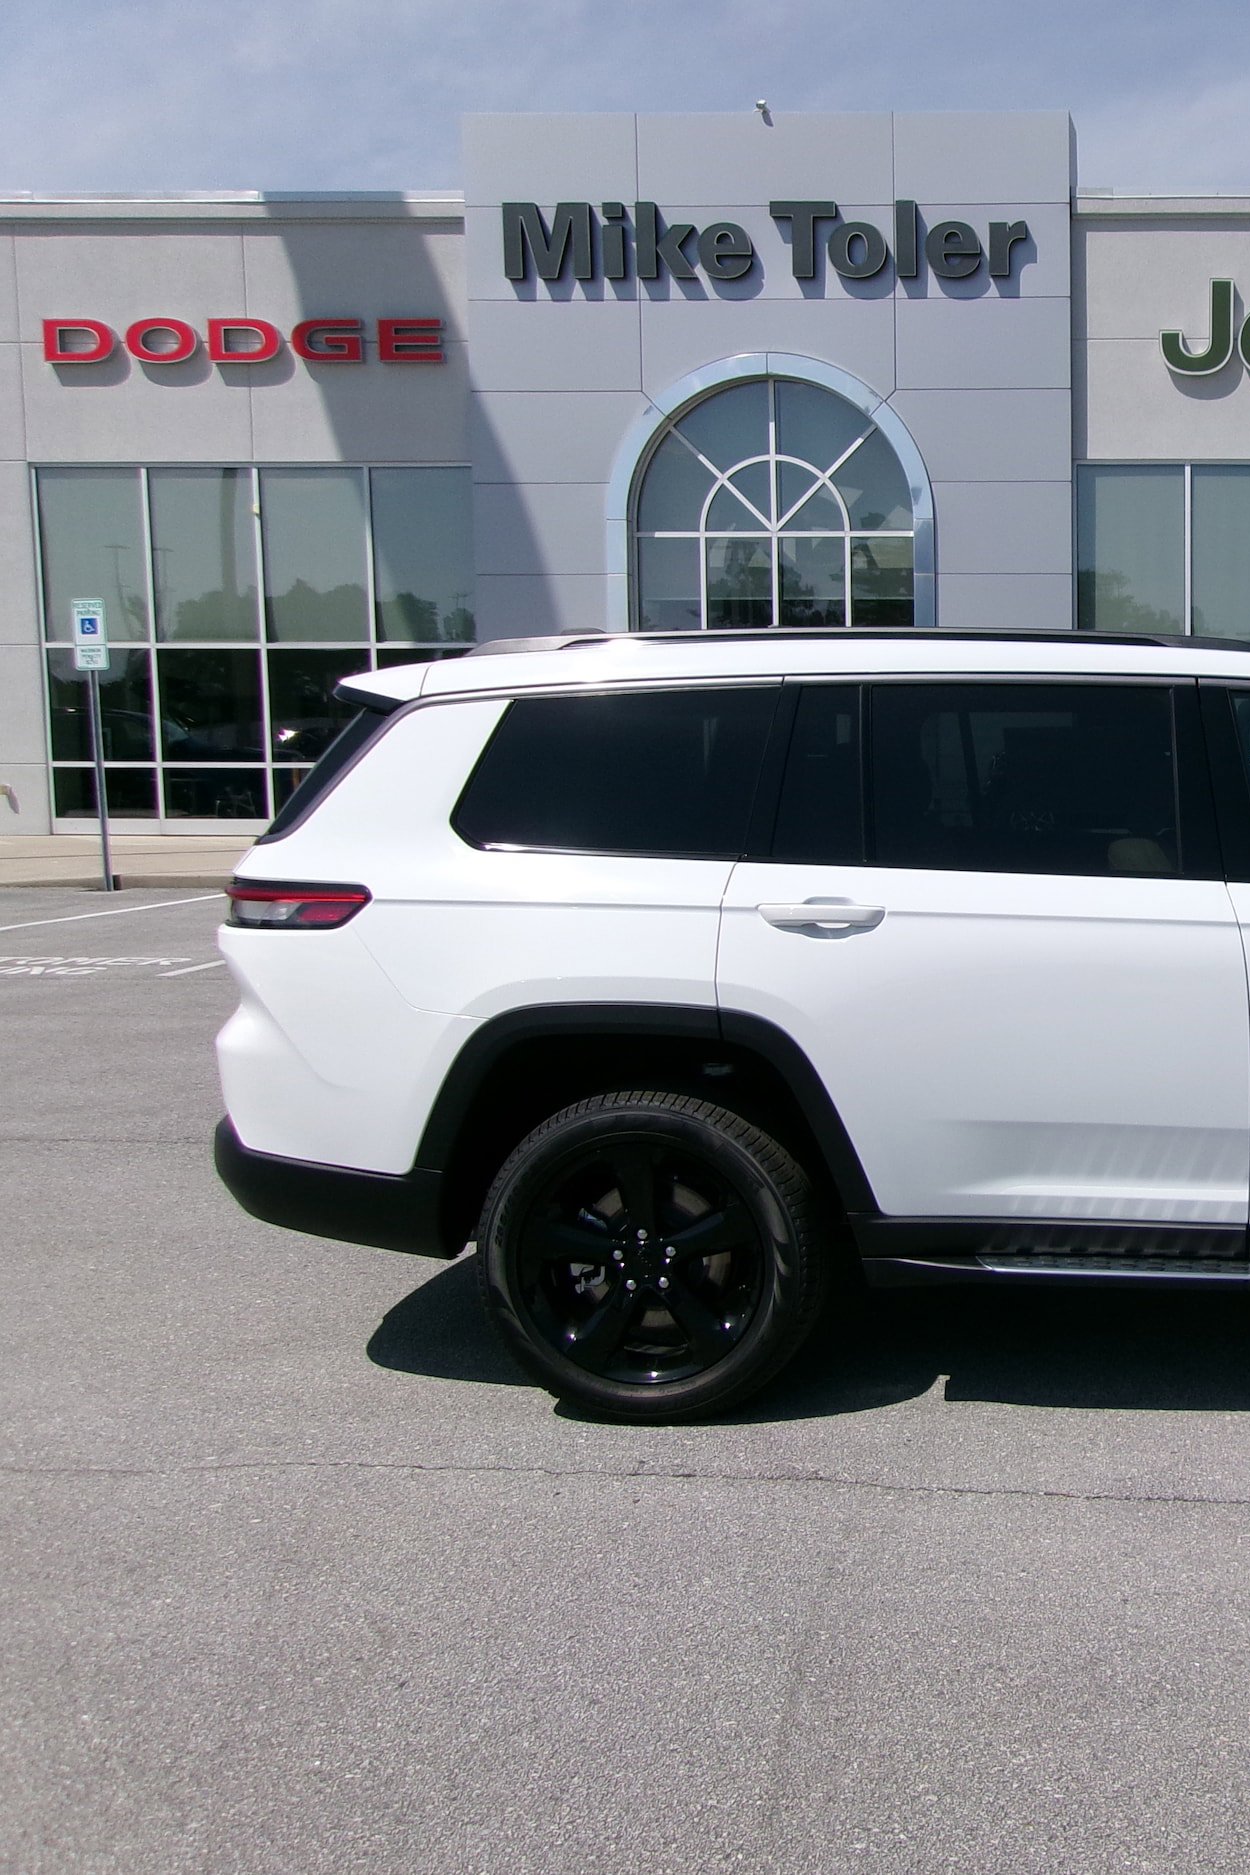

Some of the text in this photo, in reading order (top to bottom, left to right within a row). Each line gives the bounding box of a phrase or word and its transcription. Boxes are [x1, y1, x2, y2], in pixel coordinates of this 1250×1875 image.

[502, 200, 1028, 279] Mike Toler
[42, 317, 445, 364] DODGE
[0, 966, 107, 975] ING
